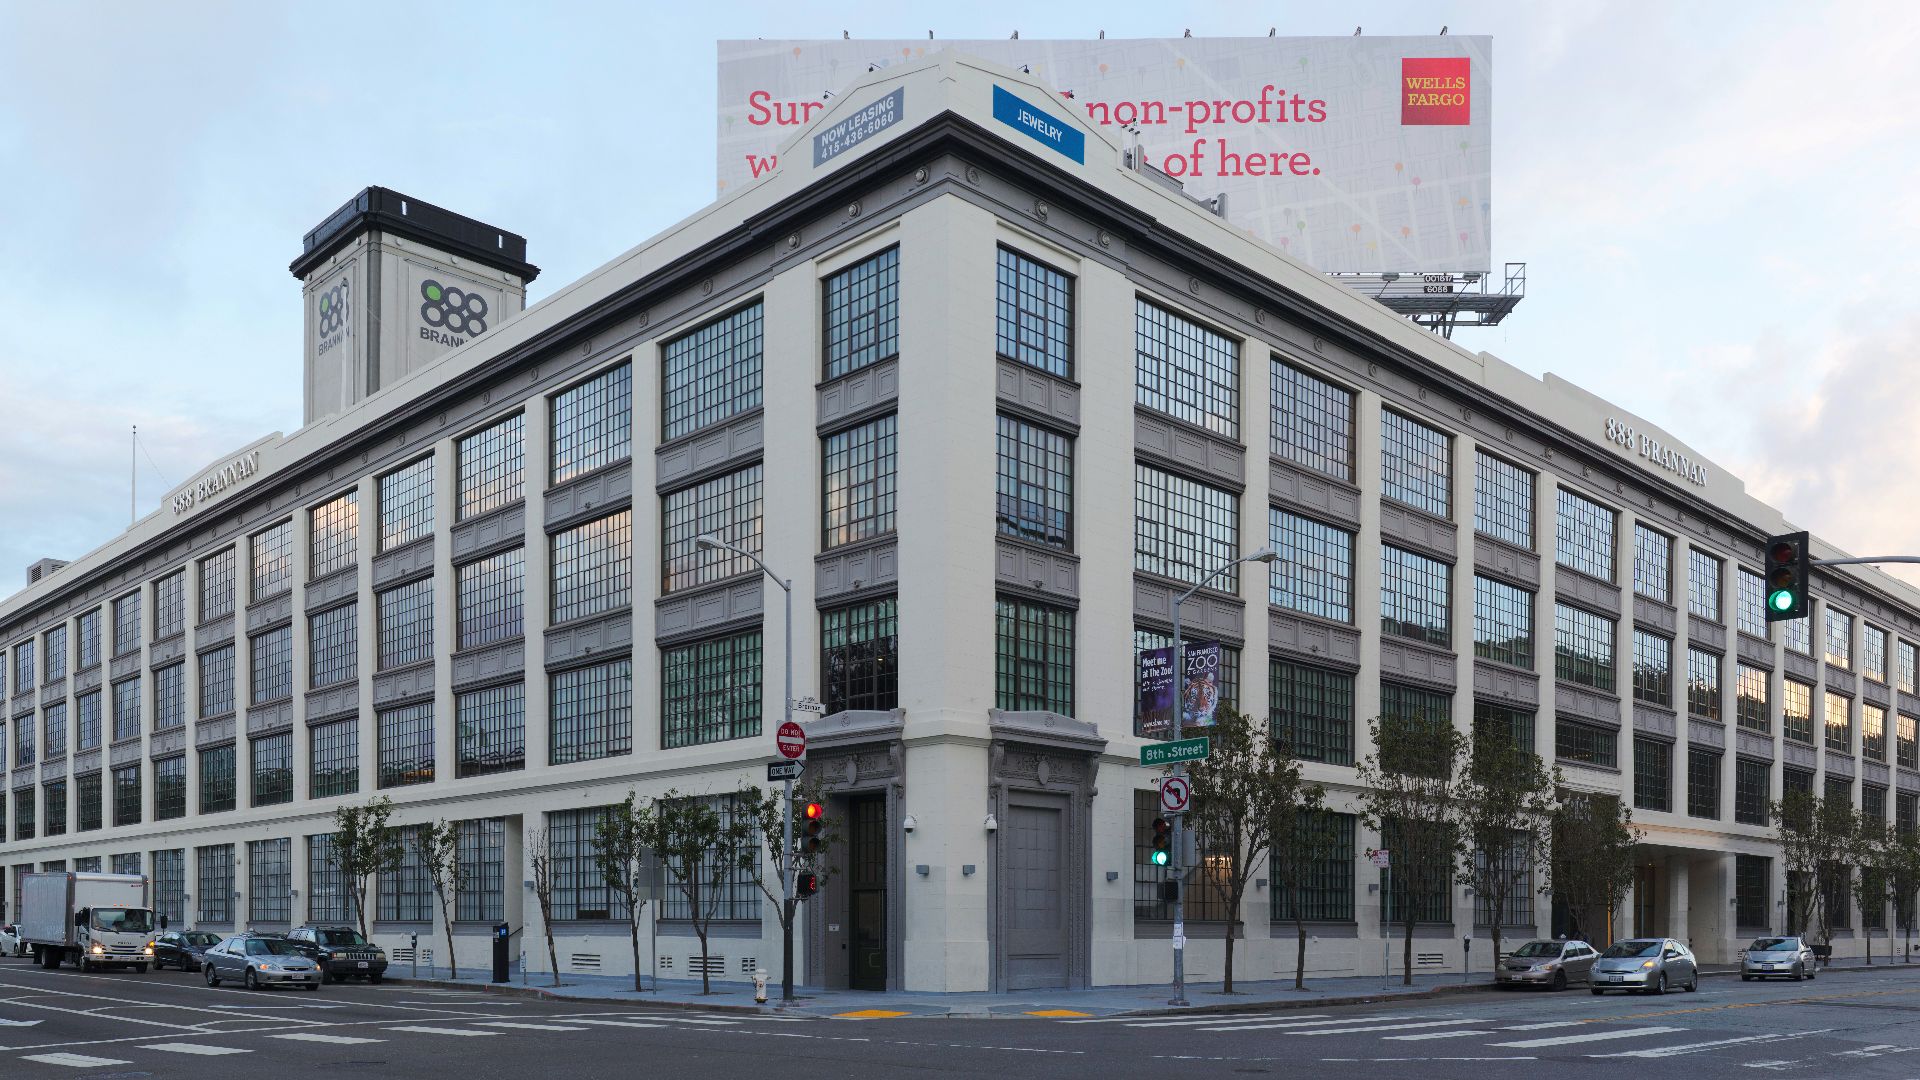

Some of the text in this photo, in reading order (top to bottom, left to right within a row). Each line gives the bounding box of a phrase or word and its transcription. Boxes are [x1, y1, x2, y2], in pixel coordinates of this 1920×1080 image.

[1405, 77, 1466, 90] WELLS
[1407, 93, 1465, 107] FARGO
[821, 96, 894, 147] NOW LEASING
[1017, 108, 1063, 142] JEWELRY
[1085, 84, 1327, 134] non-profits
[821, 111, 894, 159] 415-436-6060
[1163, 138, 1207, 177] of
[1217, 138, 1321, 177] here.
[420, 279, 489, 338] 888
[318, 326, 350, 356] BRANNN
[1604, 417, 1709, 487] 888 BRANNAN
[172, 451, 259, 515] 888 BRANNAN
[1187, 654, 1218, 671] ZOO
[782, 744, 800, 753] ENTER
[1146, 743, 1204, 761] 8th Street
[771, 766, 795, 775] ONE WAY
